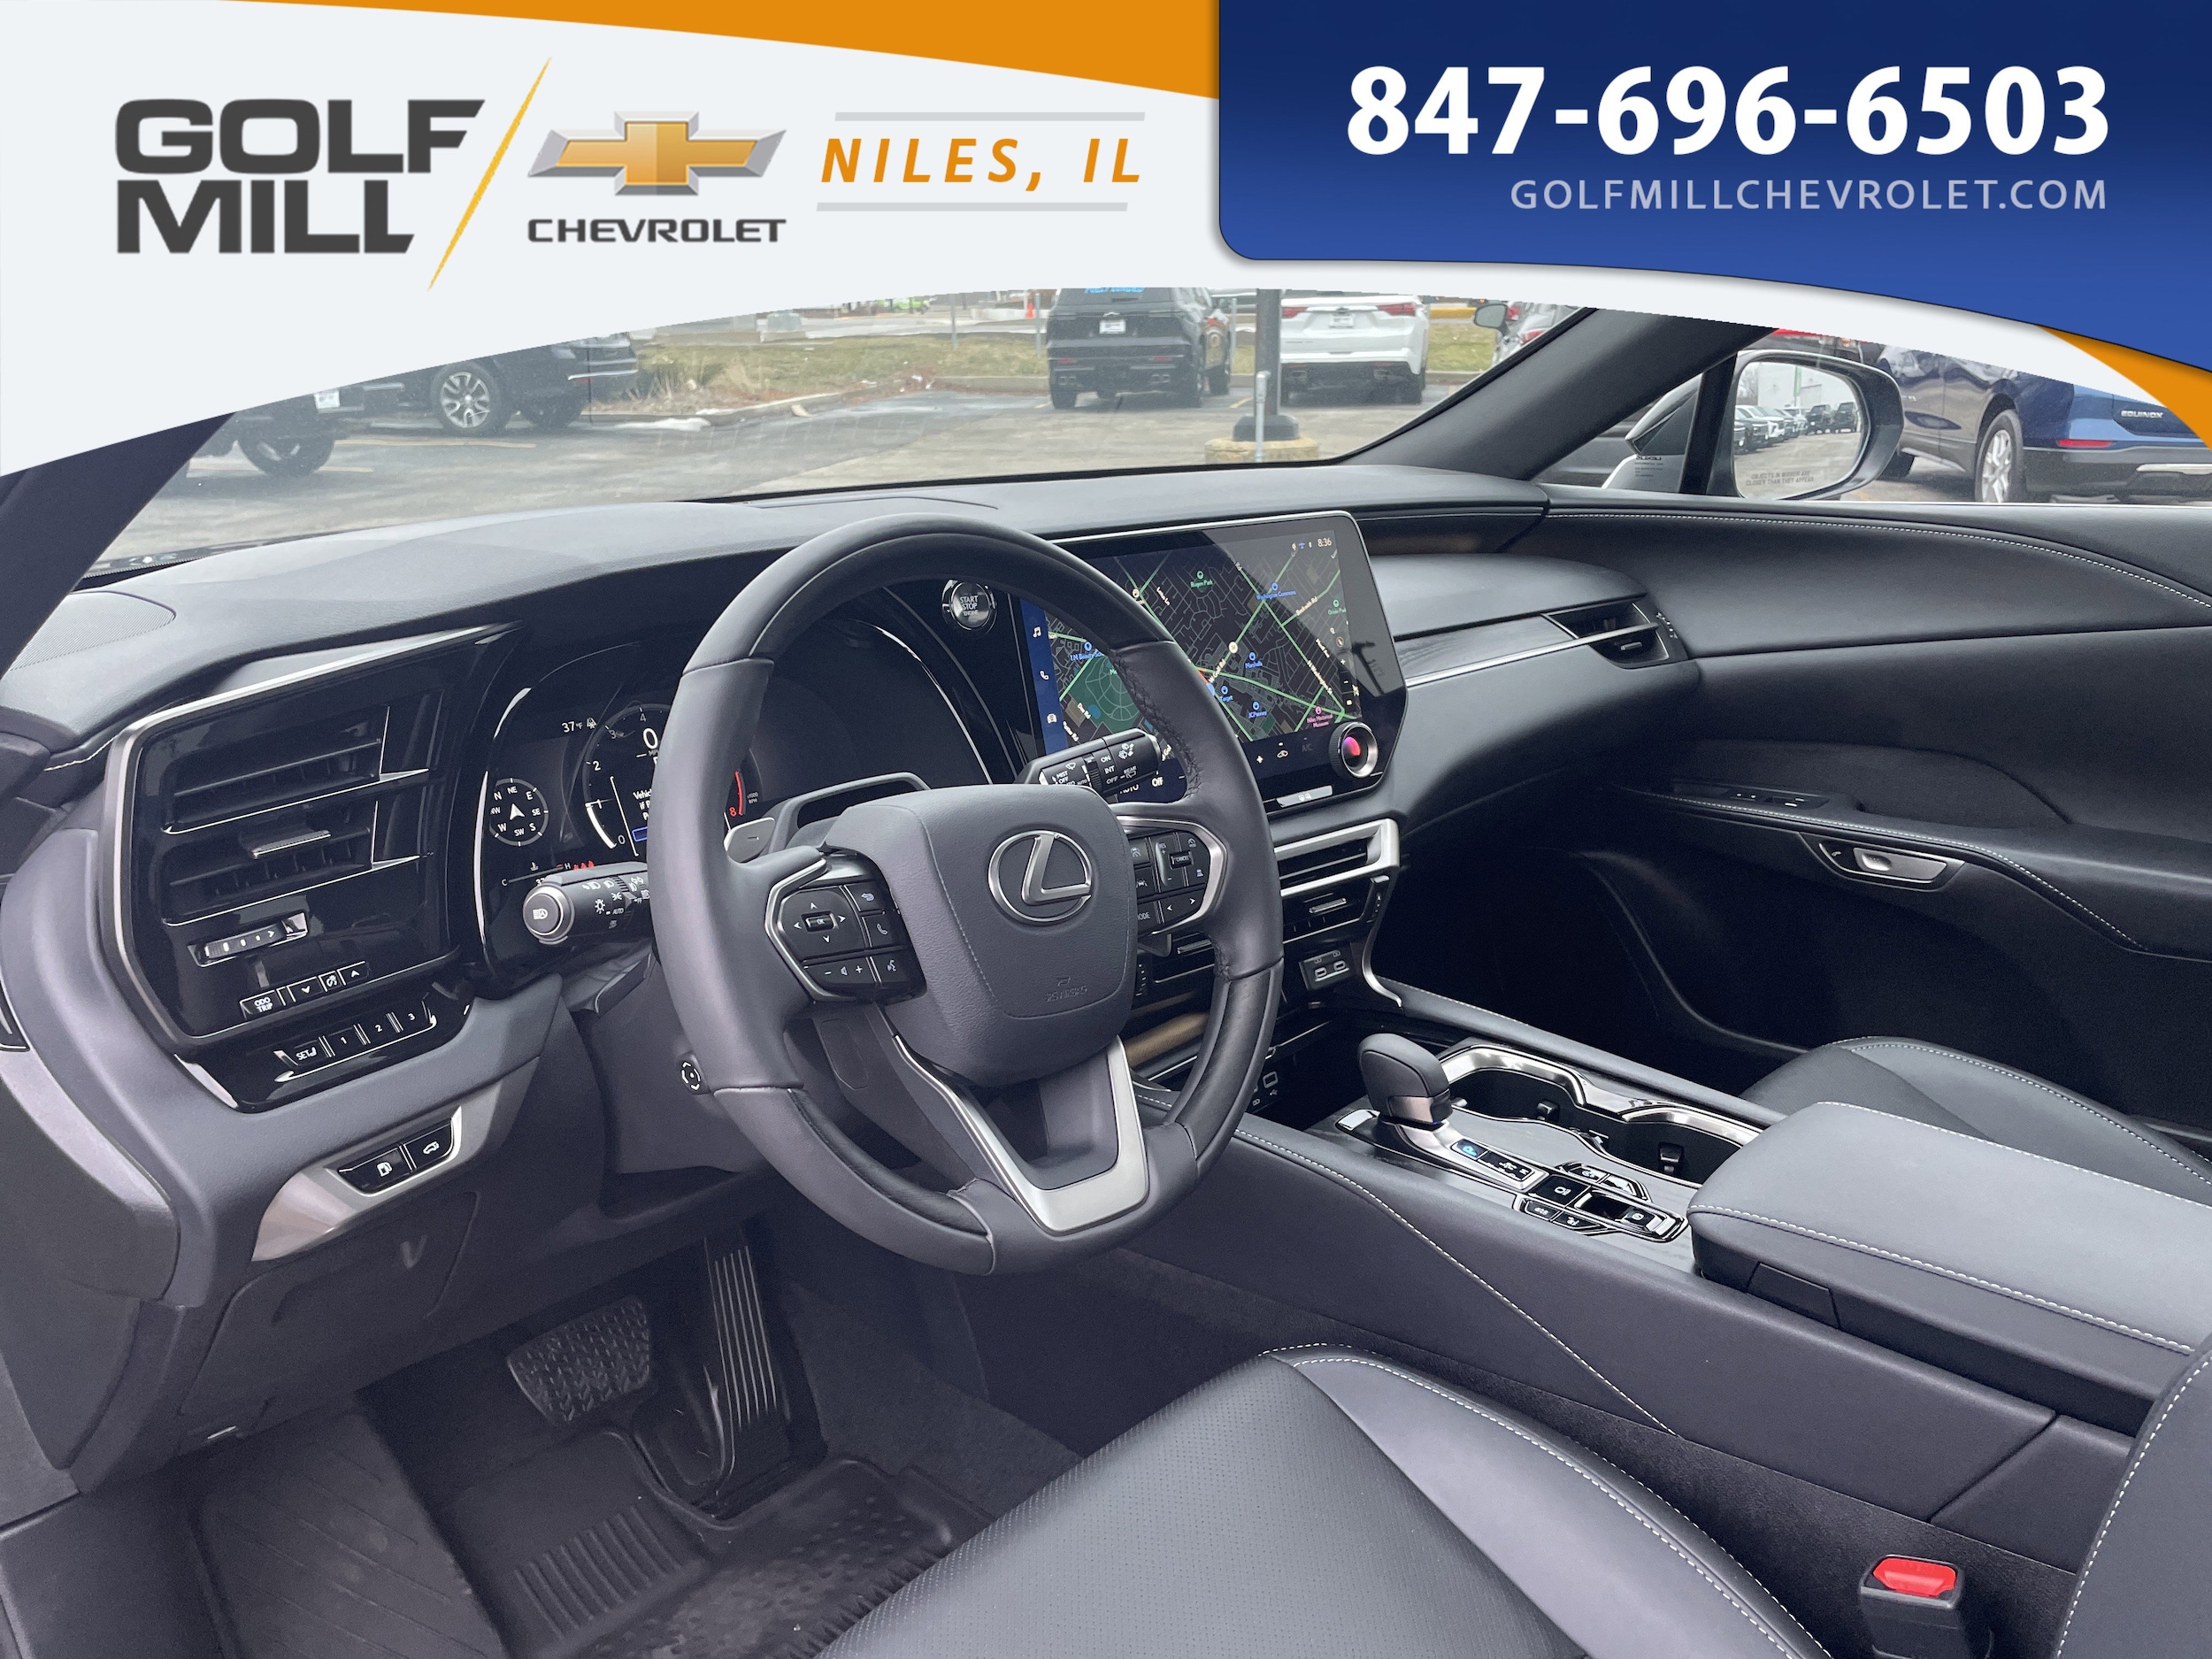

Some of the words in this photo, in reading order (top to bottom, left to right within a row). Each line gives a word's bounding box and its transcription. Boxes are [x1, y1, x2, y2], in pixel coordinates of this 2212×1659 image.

[2121, 410, 2164, 419] EQUINOX
[1317, 538, 1332, 547] 8:36
[640, 713, 647, 722] 4
[609, 730, 617, 739] 3
[643, 728, 658, 749] 0
[593, 761, 601, 771] 2
[1105, 765, 1115, 774] INT
[1106, 776, 1118, 785] OFF
[1151, 777, 1164, 787] Off
[507, 786, 518, 795] NE
[494, 791, 503, 801] N
[526, 791, 534, 800] E
[729, 806, 737, 817] 8
[497, 823, 507, 832] W
[618, 834, 626, 845] 0
[254, 996, 271, 1007] ODO
[257, 1002, 273, 1013] TRIP
[296, 1049, 311, 1061] SET
